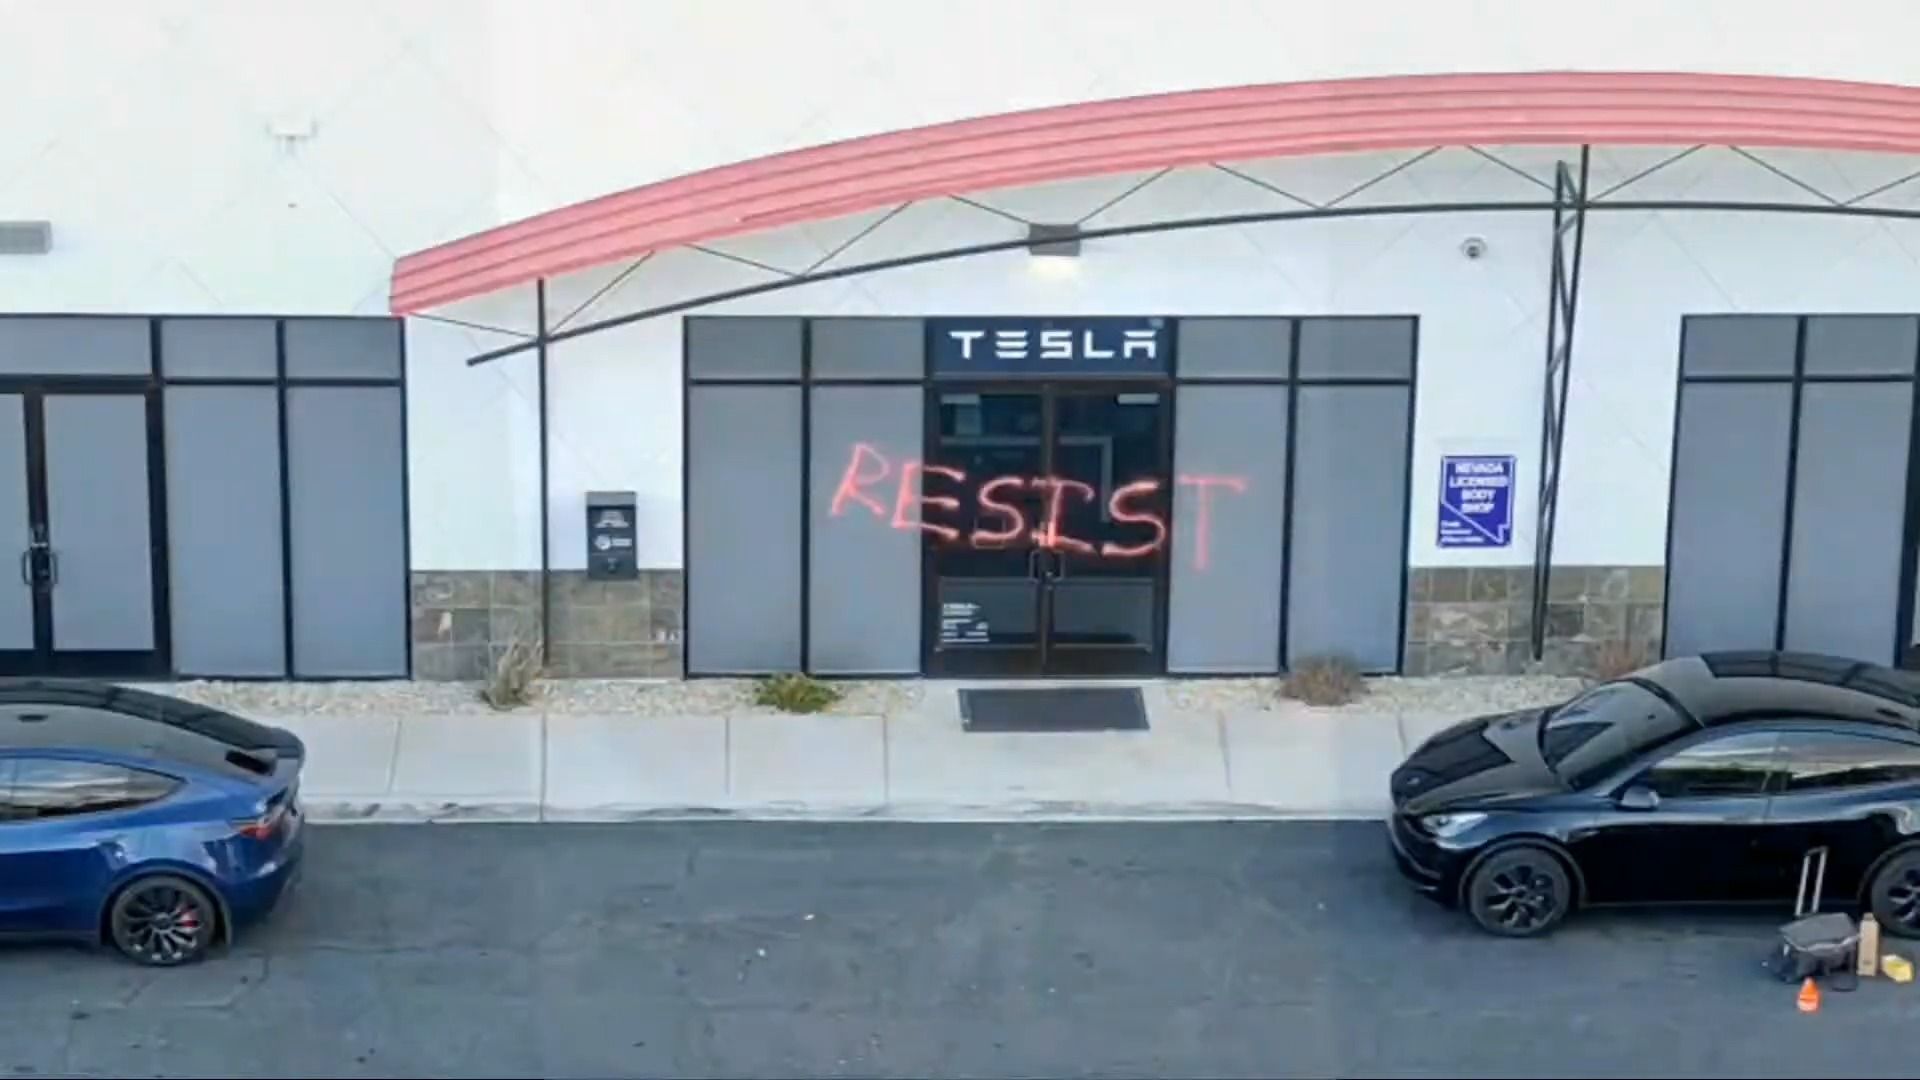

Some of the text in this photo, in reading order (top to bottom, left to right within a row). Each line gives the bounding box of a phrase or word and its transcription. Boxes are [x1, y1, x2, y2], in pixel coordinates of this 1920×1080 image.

[948, 330, 1157, 360] TESLA
[1455, 463, 1504, 474] NEVADA
[1461, 489, 1497, 501] BODY
[829, 441, 1249, 572] RESIST
[1461, 503, 1495, 514] SHOP
